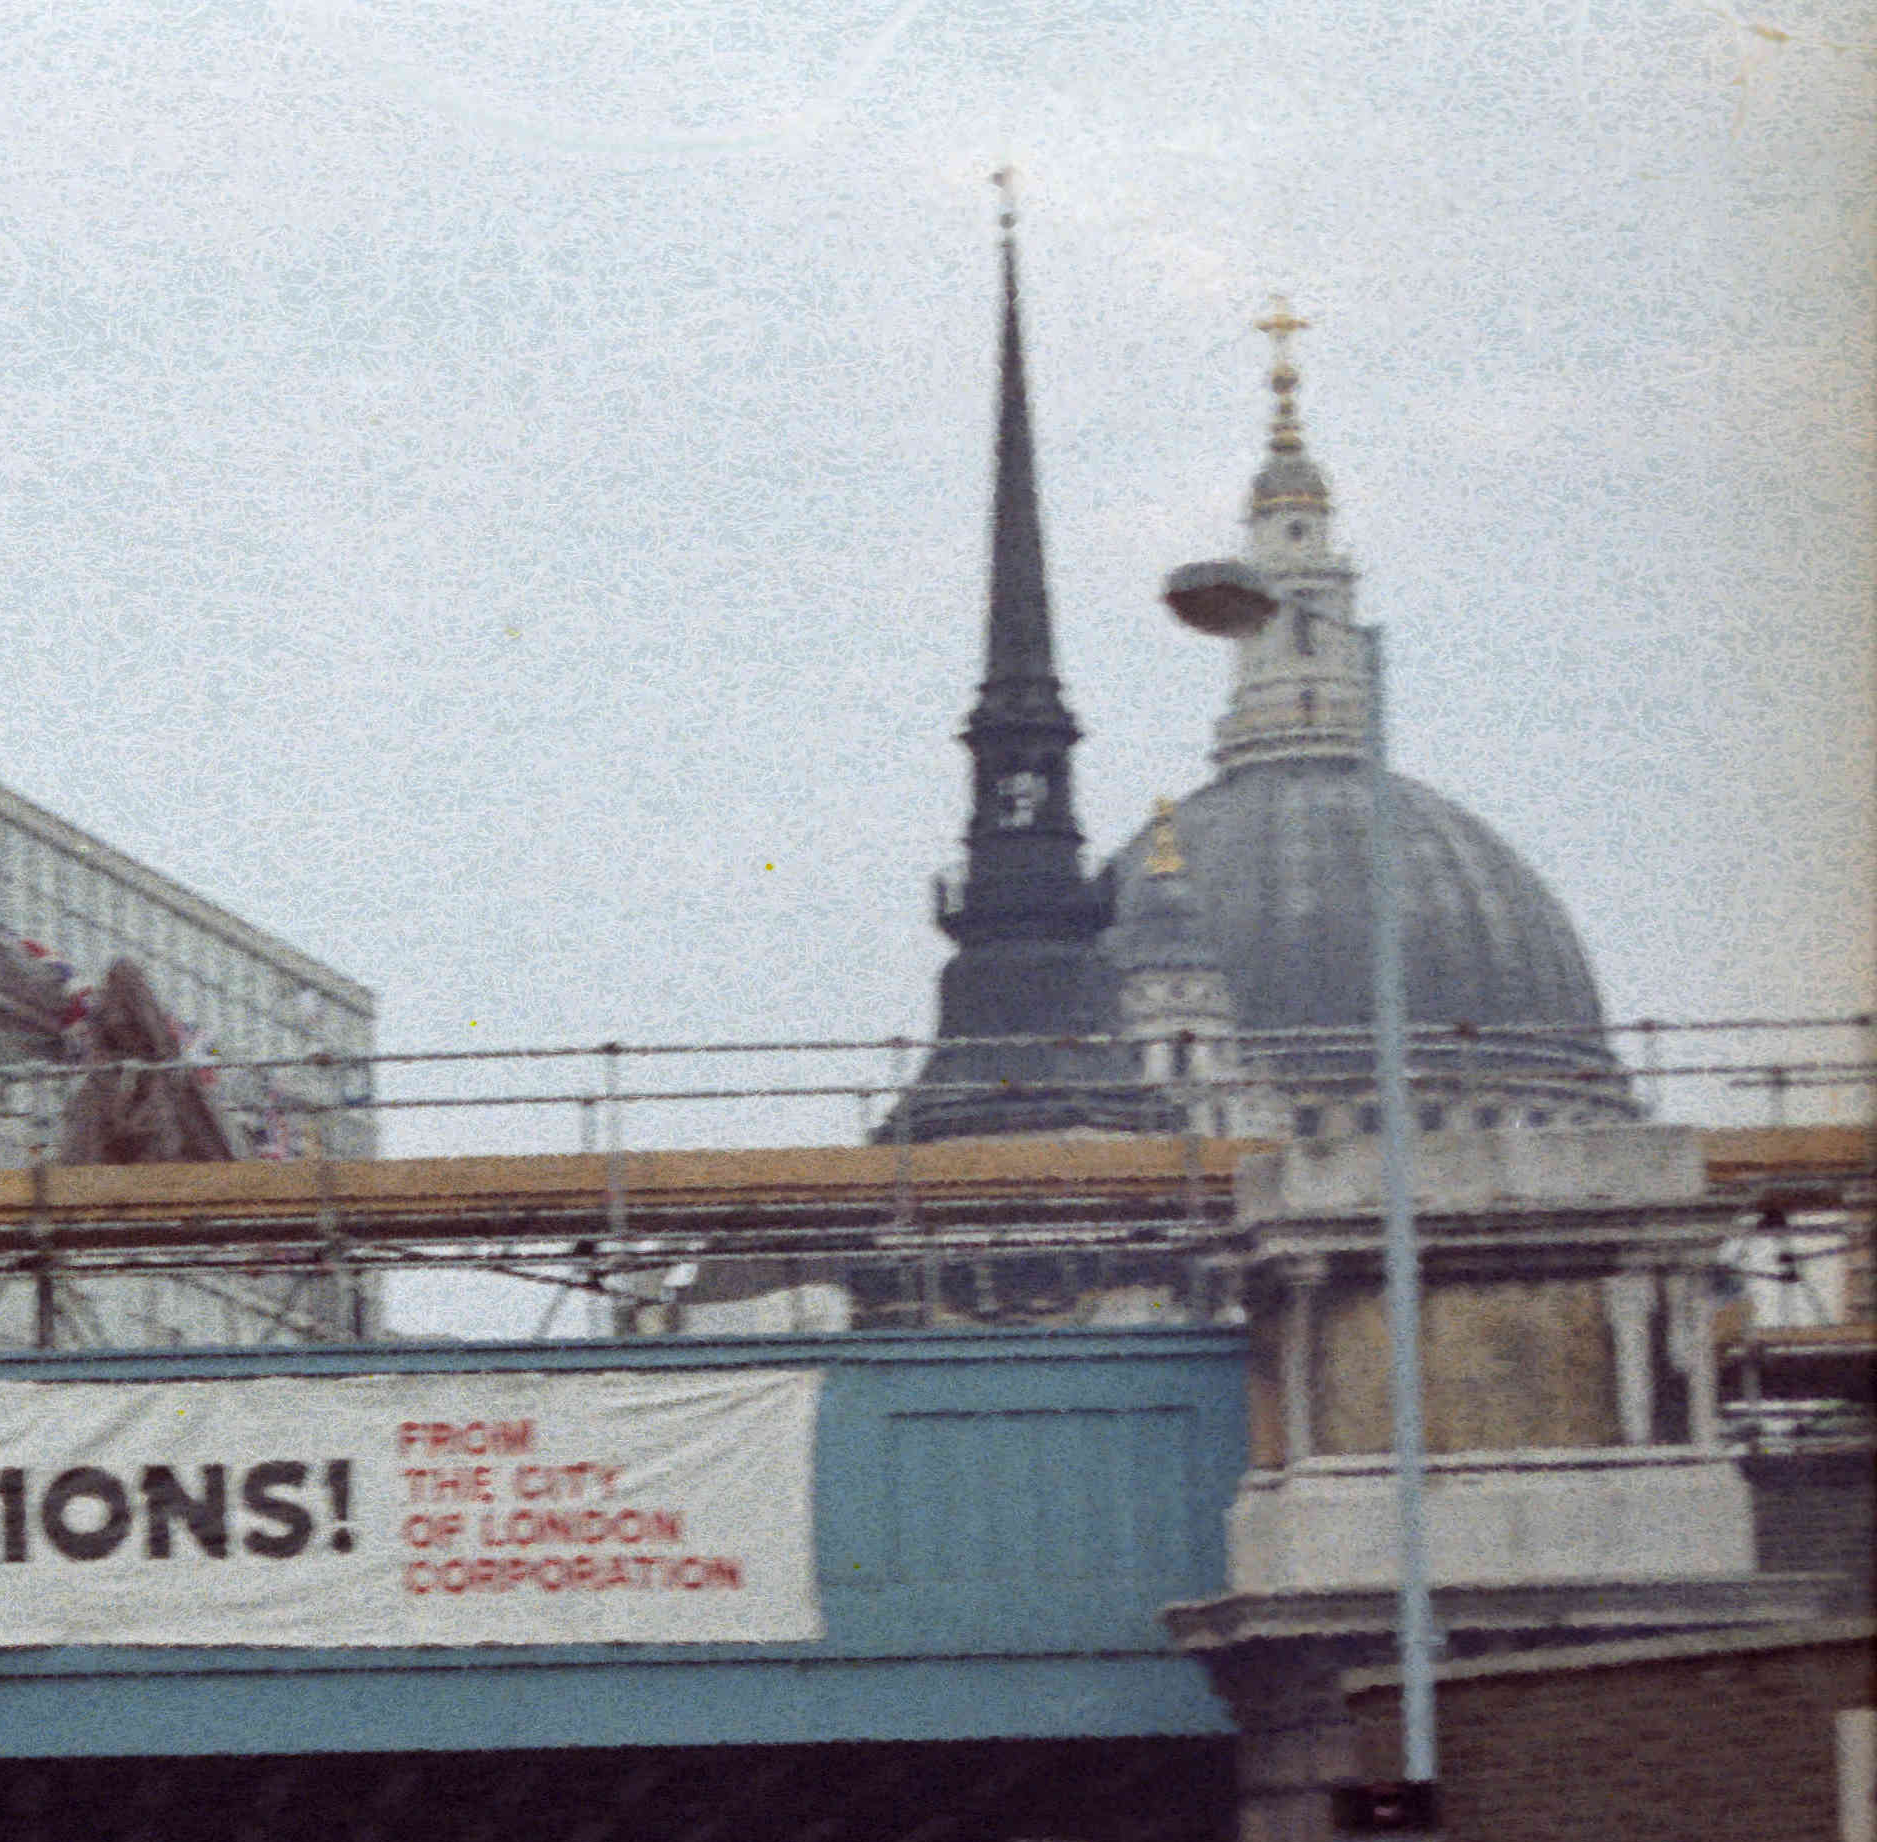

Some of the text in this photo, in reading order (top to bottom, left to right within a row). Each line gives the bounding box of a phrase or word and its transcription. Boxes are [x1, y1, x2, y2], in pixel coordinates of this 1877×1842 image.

[398, 1418, 536, 1455] FROM
[404, 1461, 625, 1504] THE CITY
[402, 1508, 684, 1549] OF LONDON
[403, 1555, 742, 1594] CORPORATION
